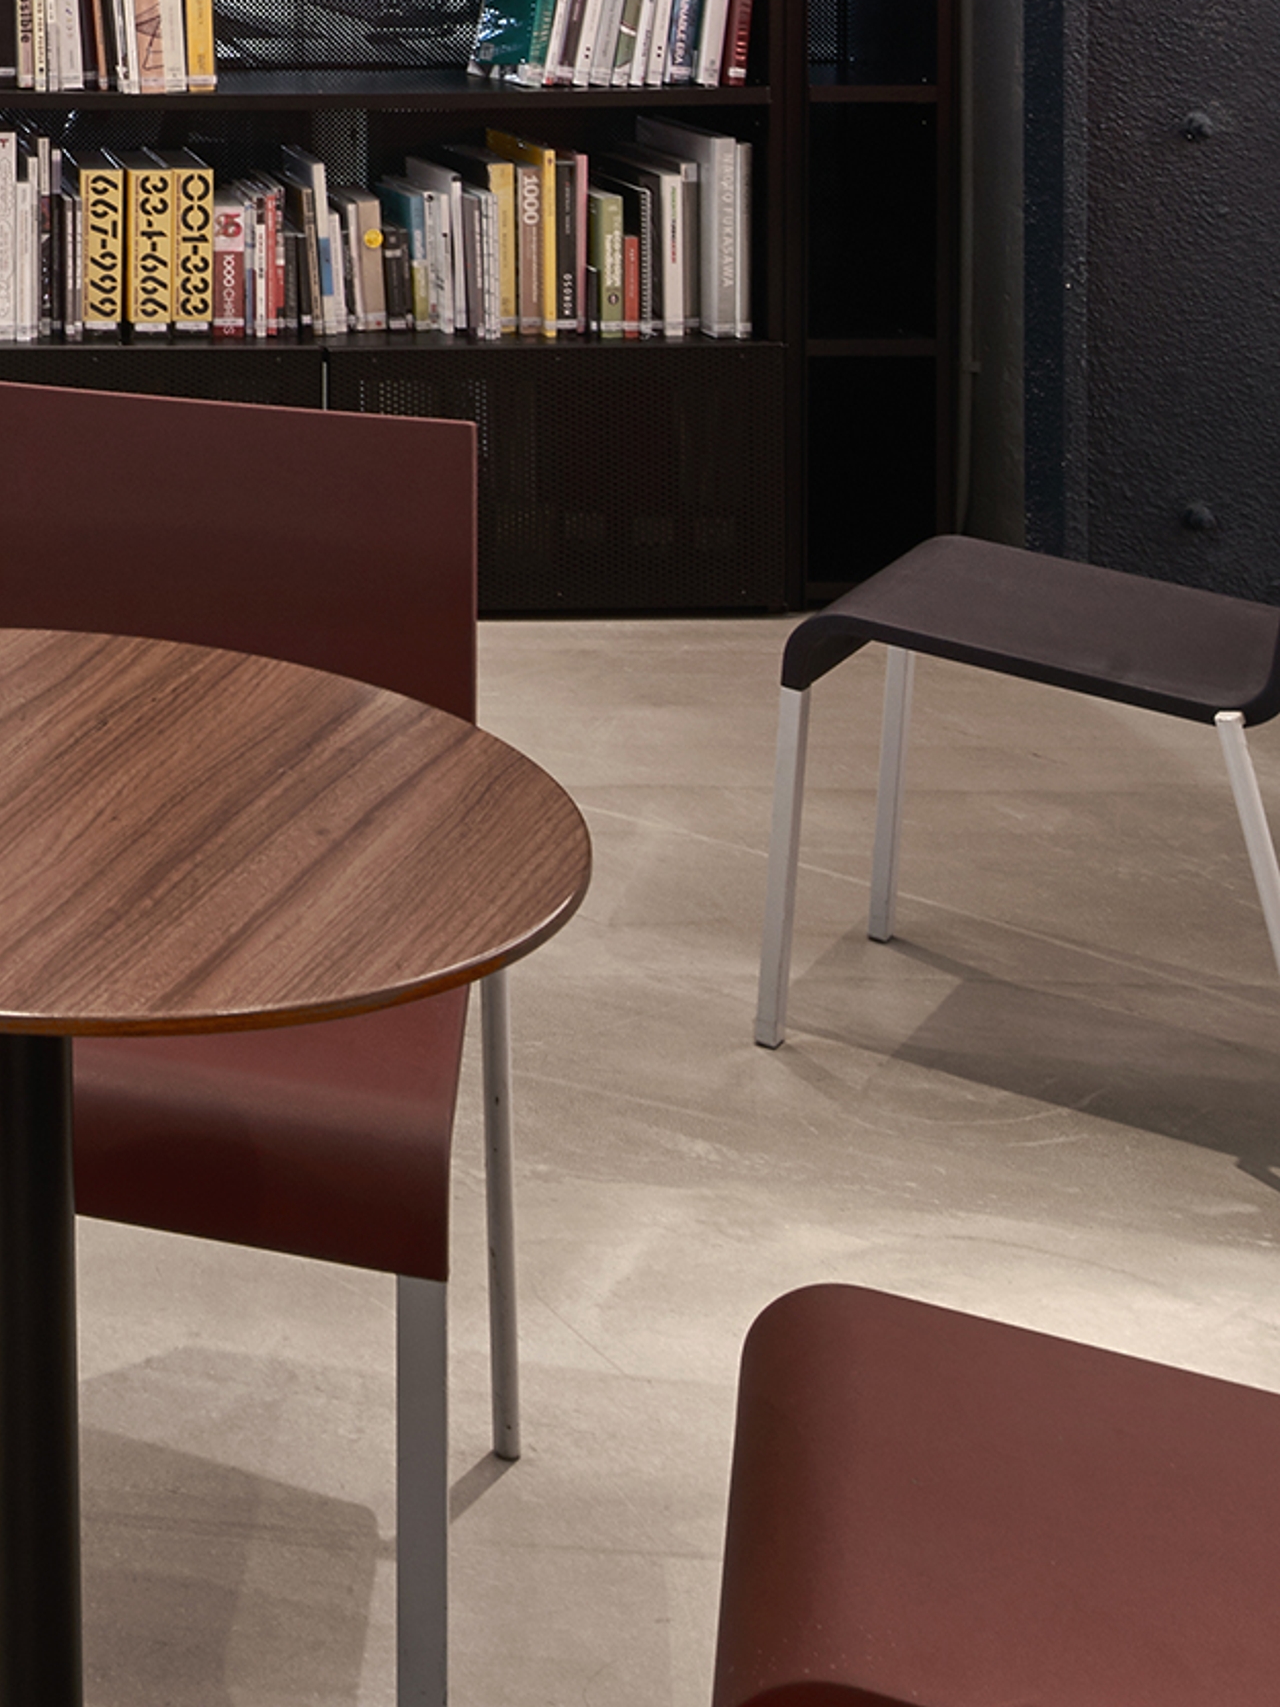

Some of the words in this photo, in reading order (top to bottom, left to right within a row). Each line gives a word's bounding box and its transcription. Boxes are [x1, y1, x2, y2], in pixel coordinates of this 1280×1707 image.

[674, 41, 687, 65] ERA
[522, 174, 540, 226] 1000
[721, 153, 734, 203] NAOTO
[90, 174, 119, 318] 667-999
[180, 173, 211, 318] 001-333
[223, 254, 235, 287] 1000
[604, 233, 615, 287] handbook
[721, 207, 734, 288] FUKASAWA
